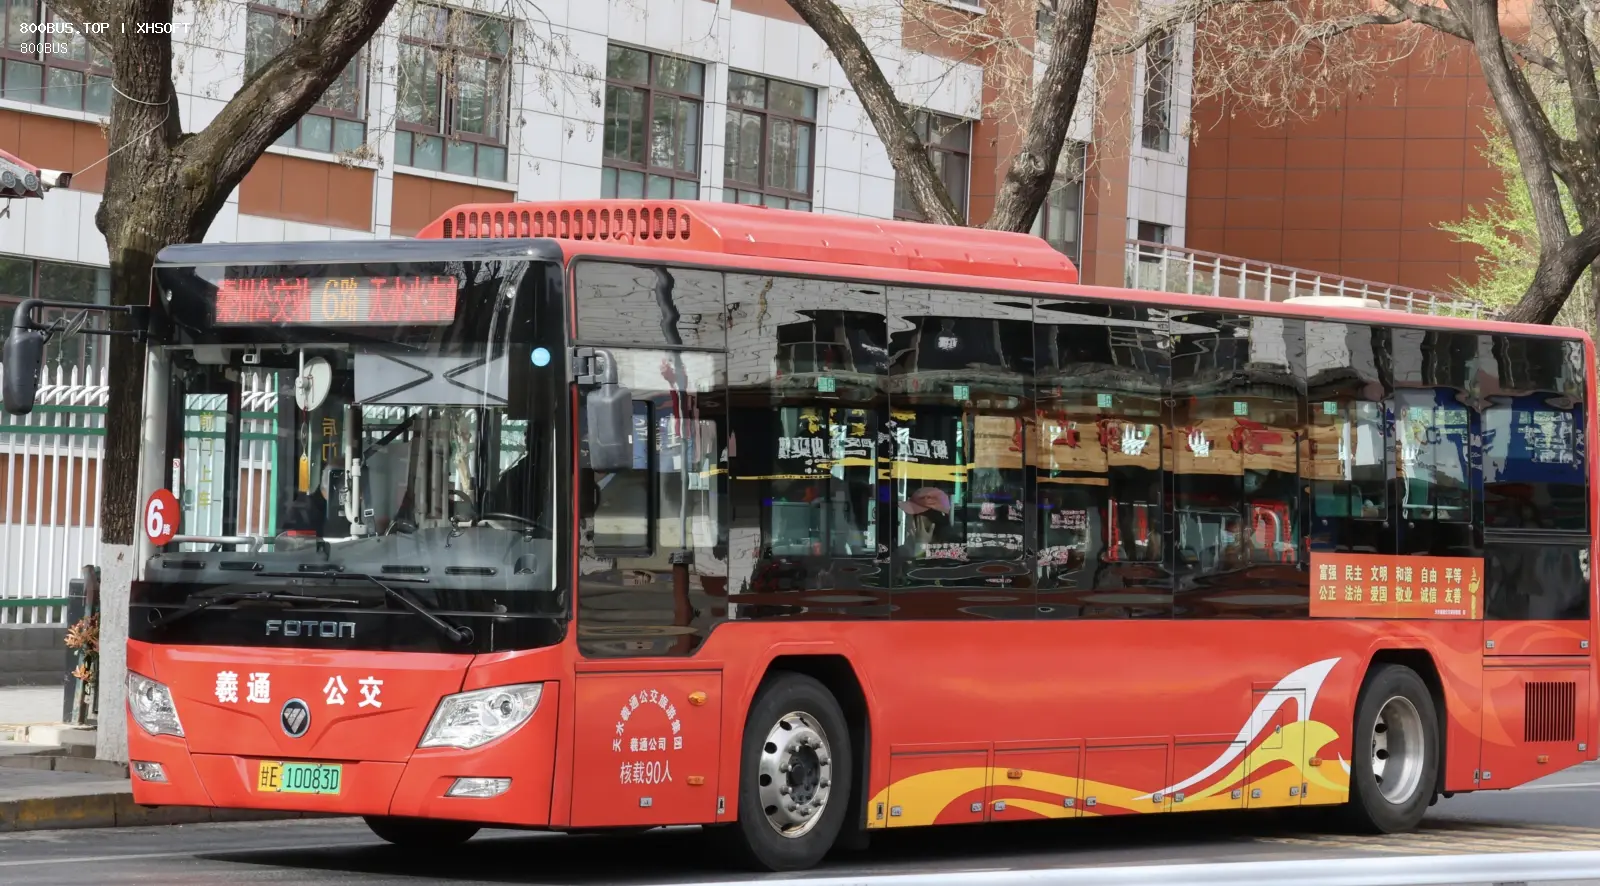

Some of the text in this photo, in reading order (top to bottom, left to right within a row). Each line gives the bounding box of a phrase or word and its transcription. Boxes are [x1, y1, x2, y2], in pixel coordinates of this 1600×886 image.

[321, 278, 359, 322] 6路
[199, 411, 214, 510] 前门上车
[147, 498, 171, 538] 6路
[1319, 564, 1462, 584] 富强 民主 文明 和谐 自由 平等
[1319, 585, 1462, 604] 公正 法治 爱国 敬业 诚信 友善
[265, 619, 356, 638] FOTON
[322, 675, 384, 709] 公交
[619, 760, 672, 784] 核载90人
